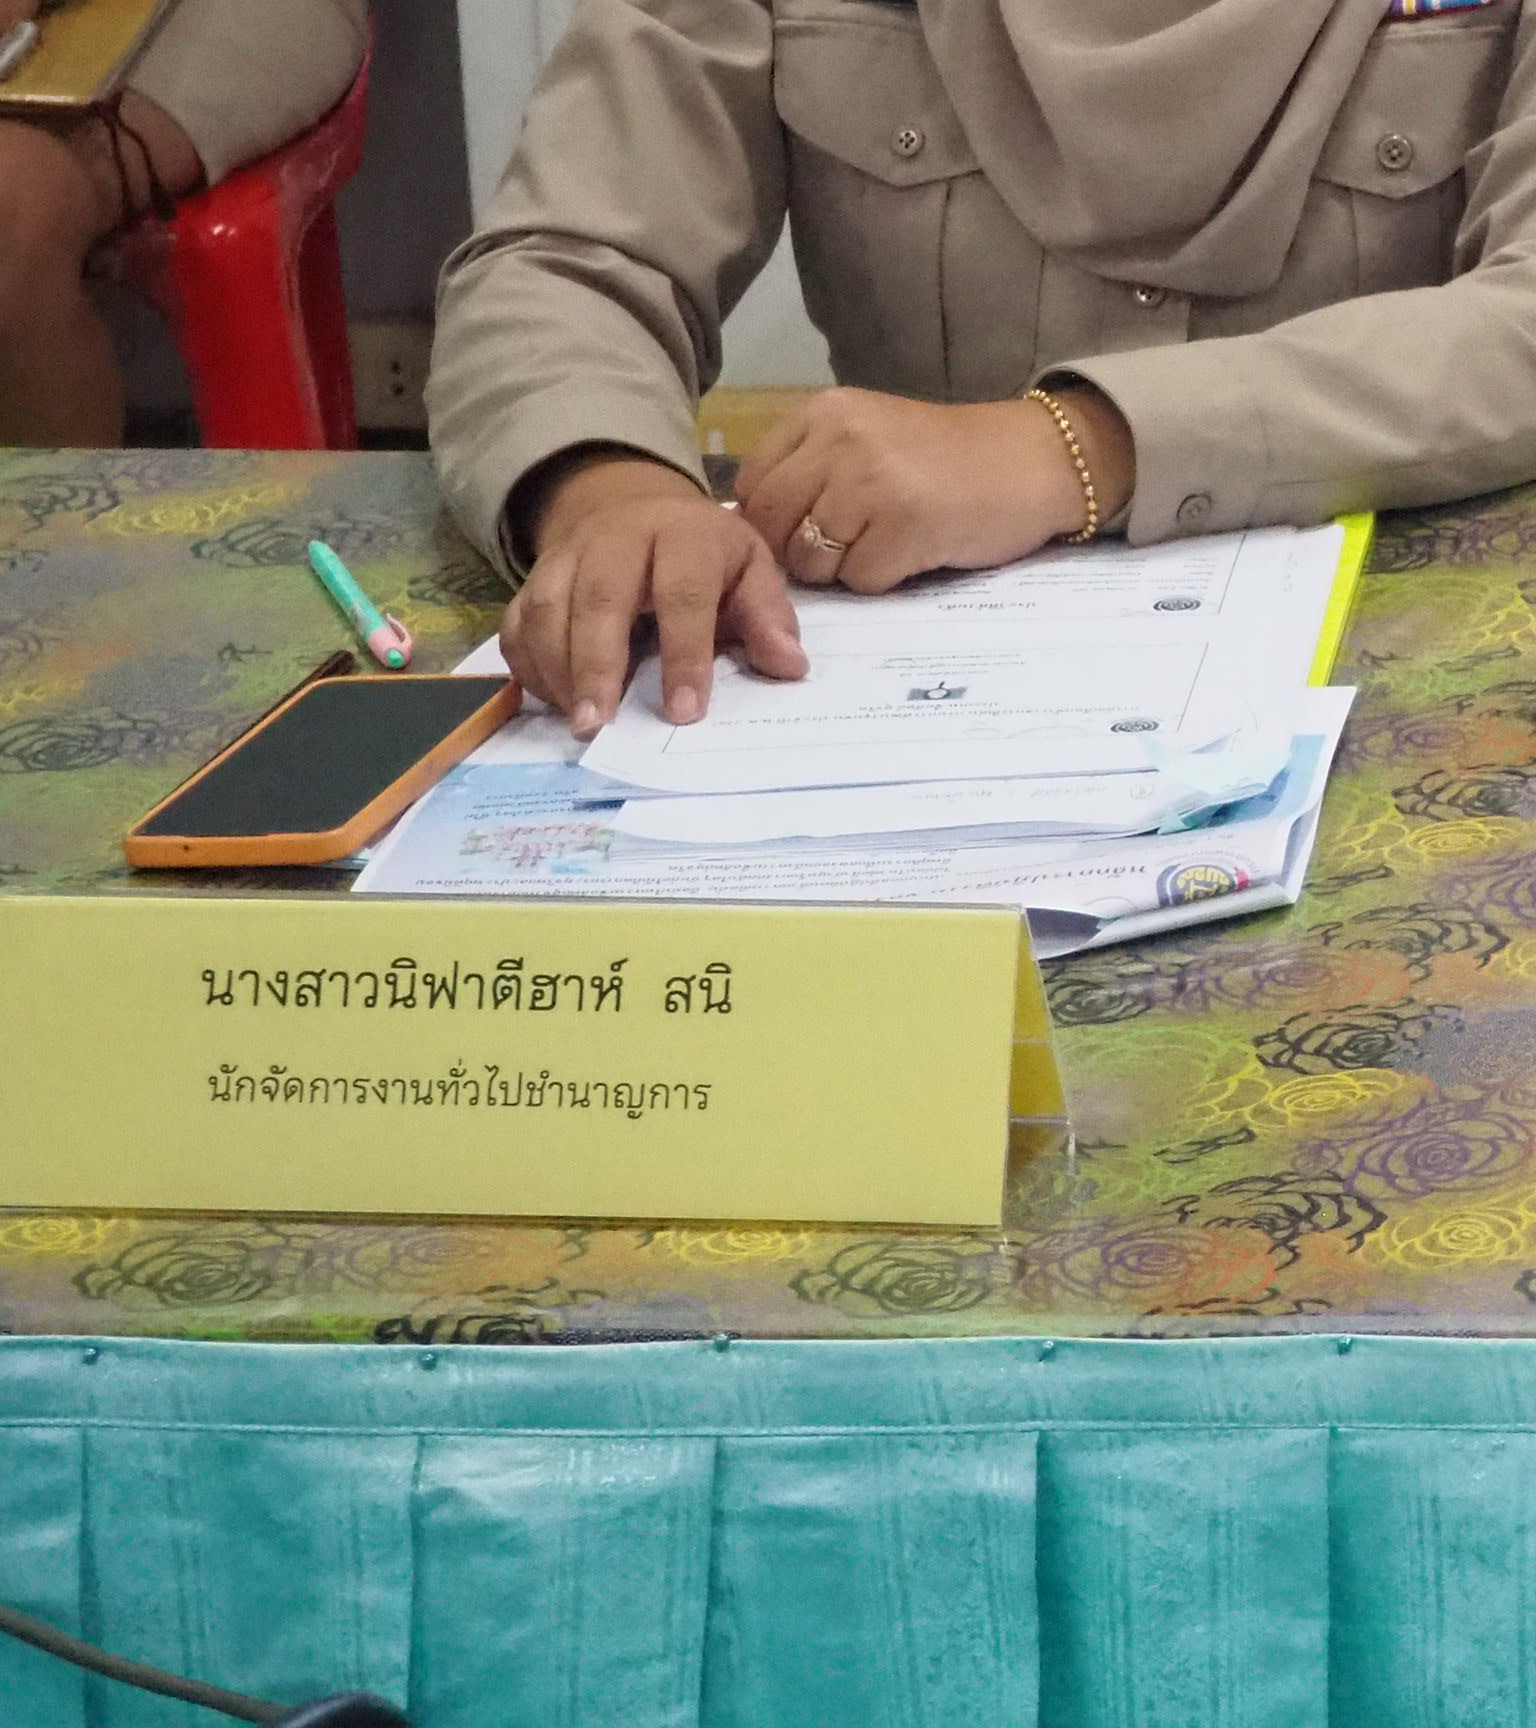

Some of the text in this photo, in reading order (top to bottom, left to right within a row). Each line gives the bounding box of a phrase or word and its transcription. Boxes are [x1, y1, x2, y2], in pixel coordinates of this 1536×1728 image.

[200, 956, 733, 1016] นางสาวนิฟาตีฮาห์ สนิ
[207, 1058, 713, 1120] นักจัดการงานทั่วไปชำนาญการ
